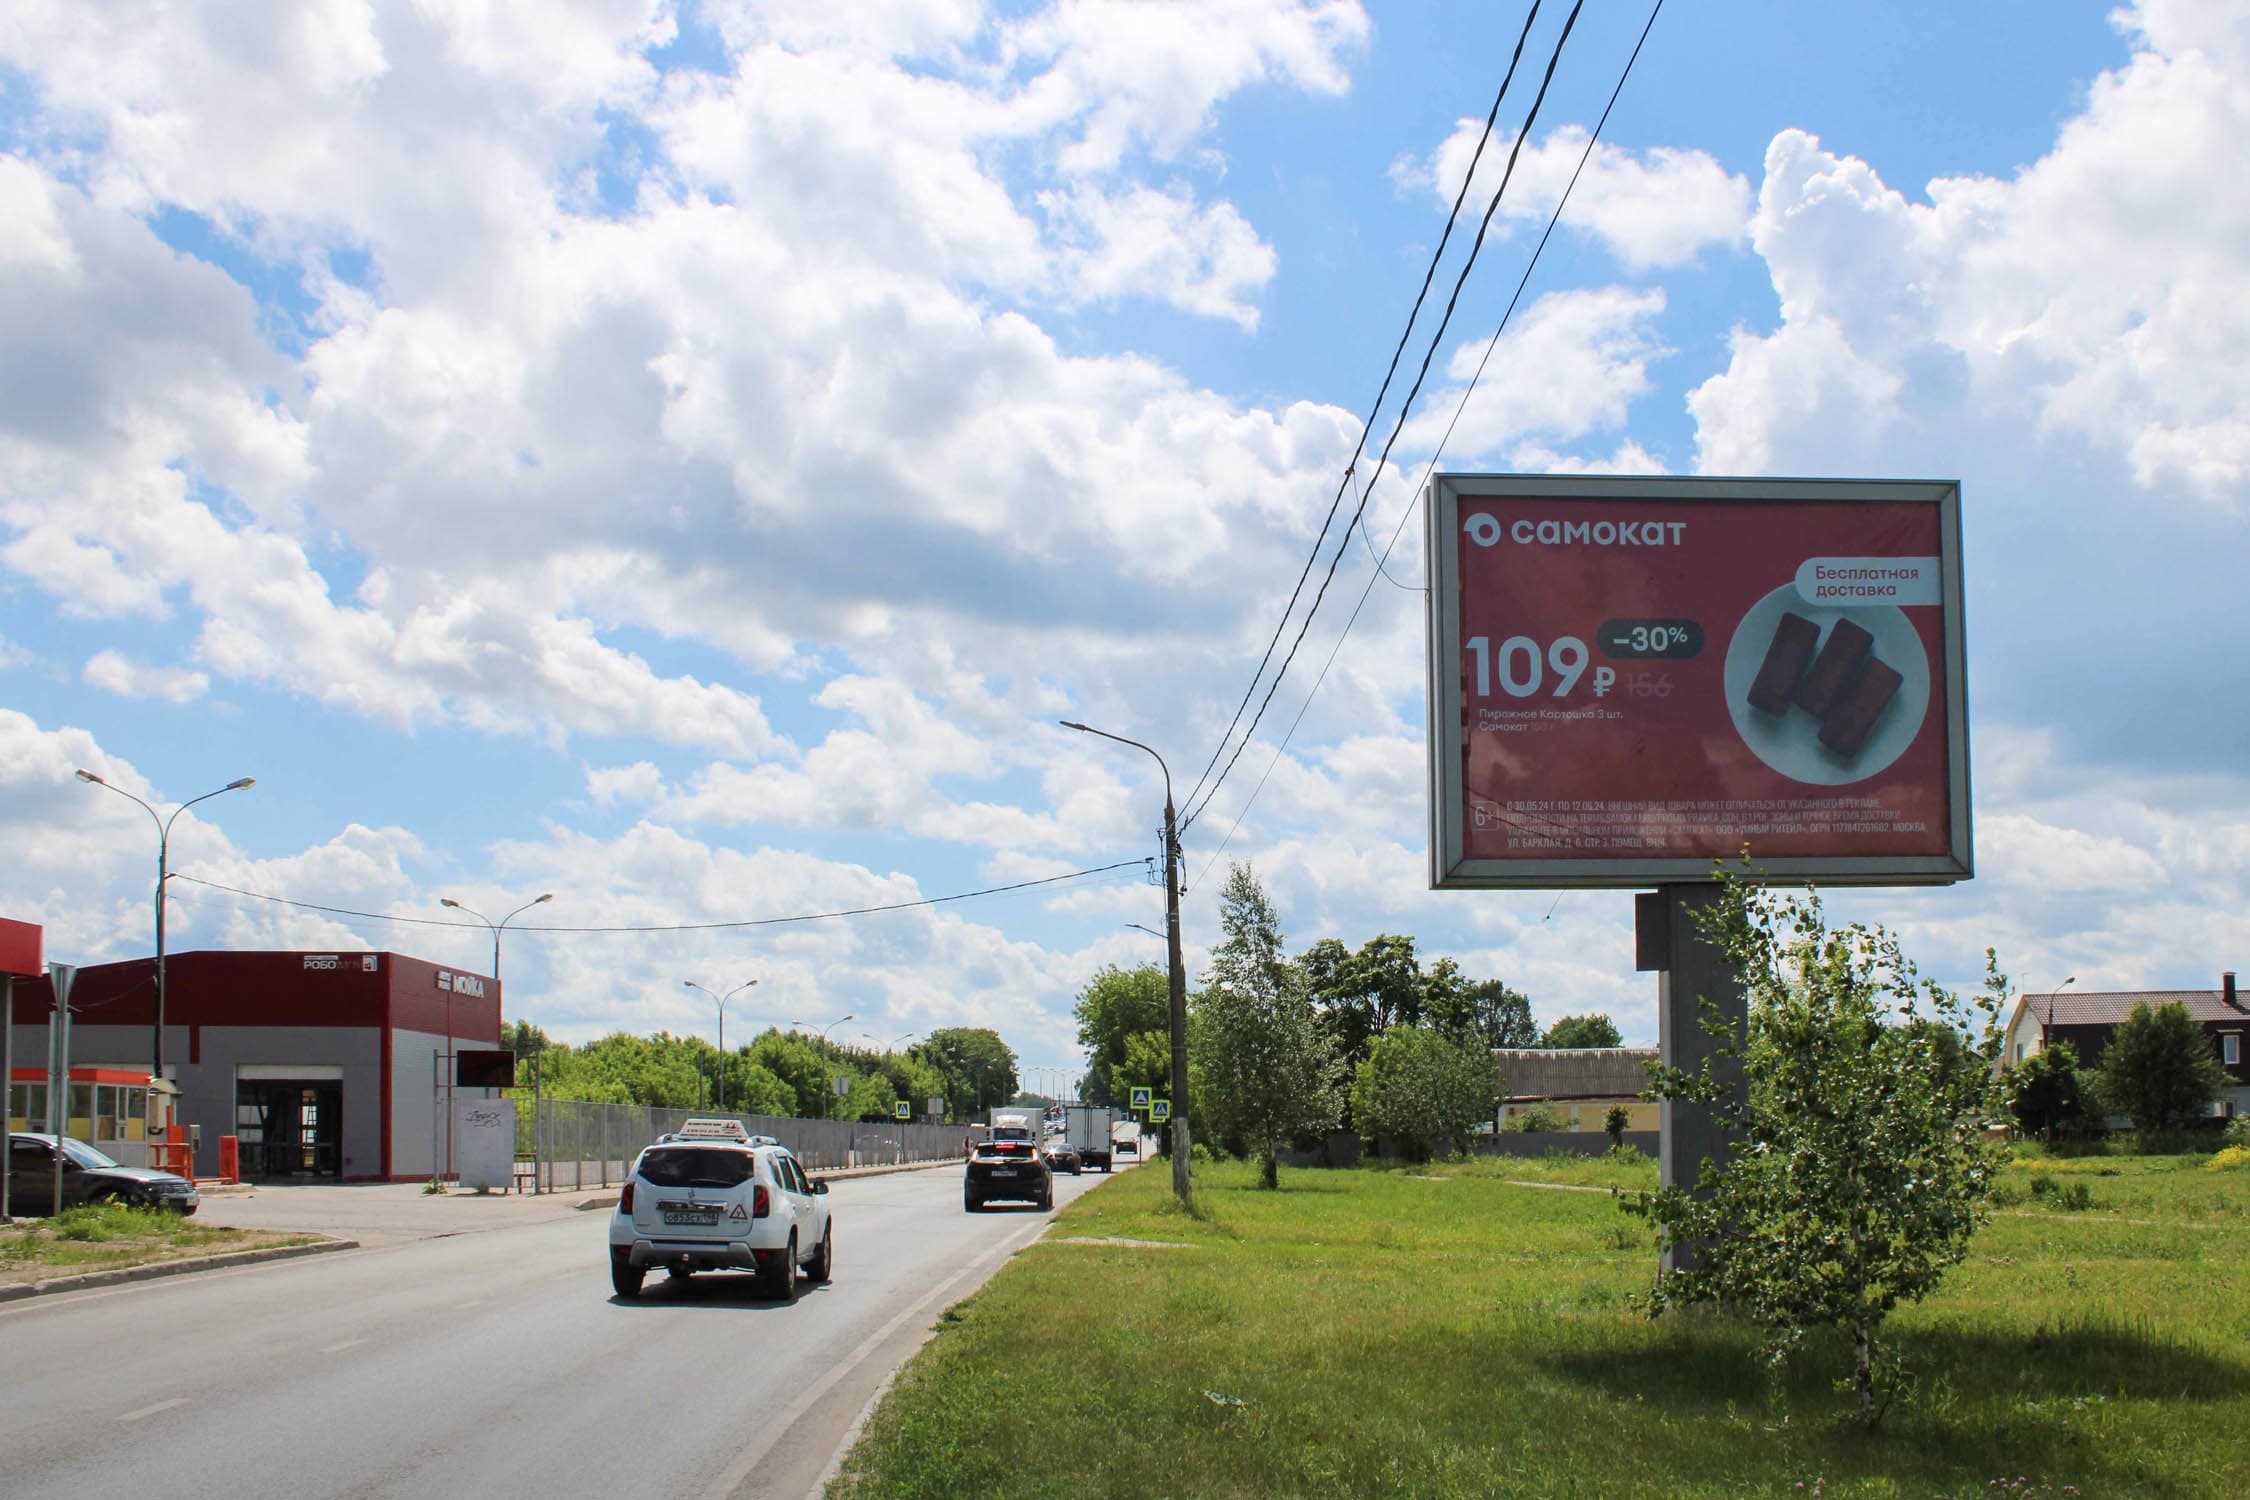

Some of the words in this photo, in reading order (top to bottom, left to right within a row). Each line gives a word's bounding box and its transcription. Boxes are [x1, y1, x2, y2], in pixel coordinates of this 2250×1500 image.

[1511, 520, 1687, 545] самокат
[1815, 566, 1919, 580] Бесплатная
[1815, 584, 1897, 598] доставка
[1479, 709, 1537, 722] Пирожное
[1540, 709, 1595, 722] Картошка
[1597, 709, 1604, 719] 3
[1606, 710, 1624, 719] шт.
[1479, 722, 1529, 732] Самокат
[1474, 806, 1494, 826] 6+
